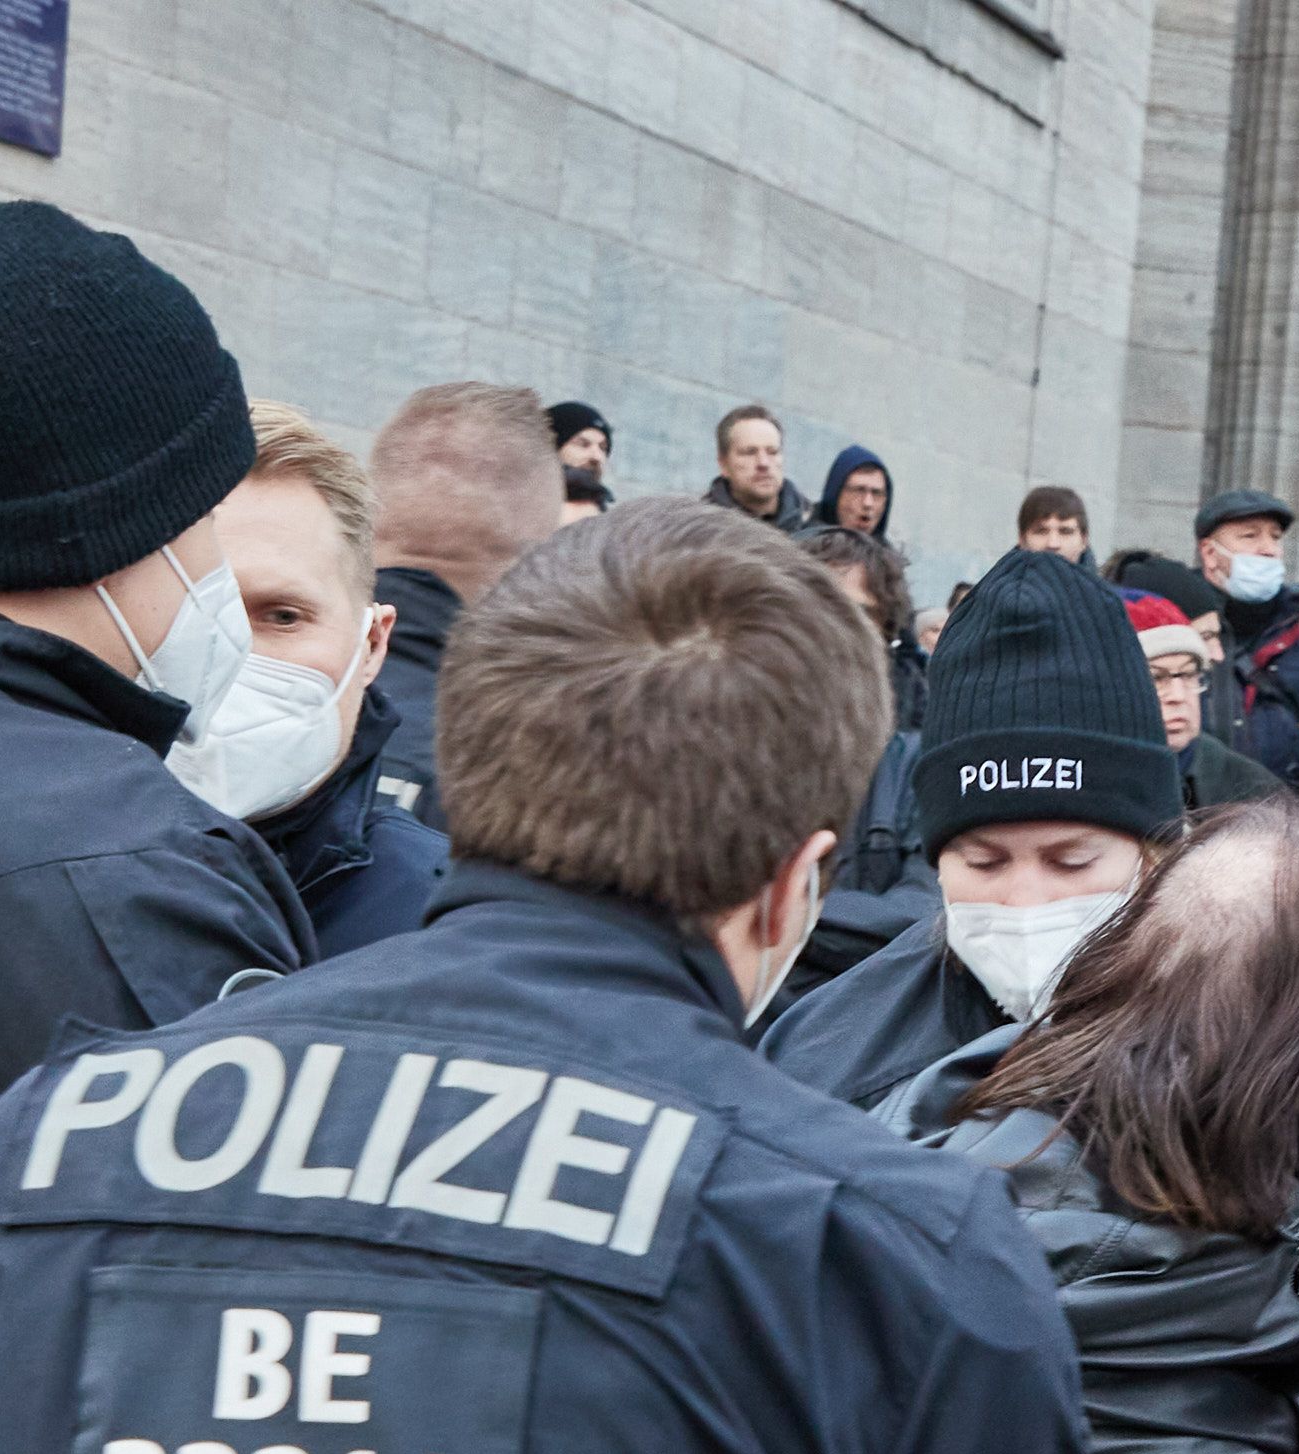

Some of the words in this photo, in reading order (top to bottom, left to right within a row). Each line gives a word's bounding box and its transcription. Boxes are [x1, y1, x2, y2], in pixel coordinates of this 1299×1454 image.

[959, 756, 1083, 798] POLIZEI
[21, 1035, 698, 1257] POLIZEI
[212, 1308, 381, 1424] BE
